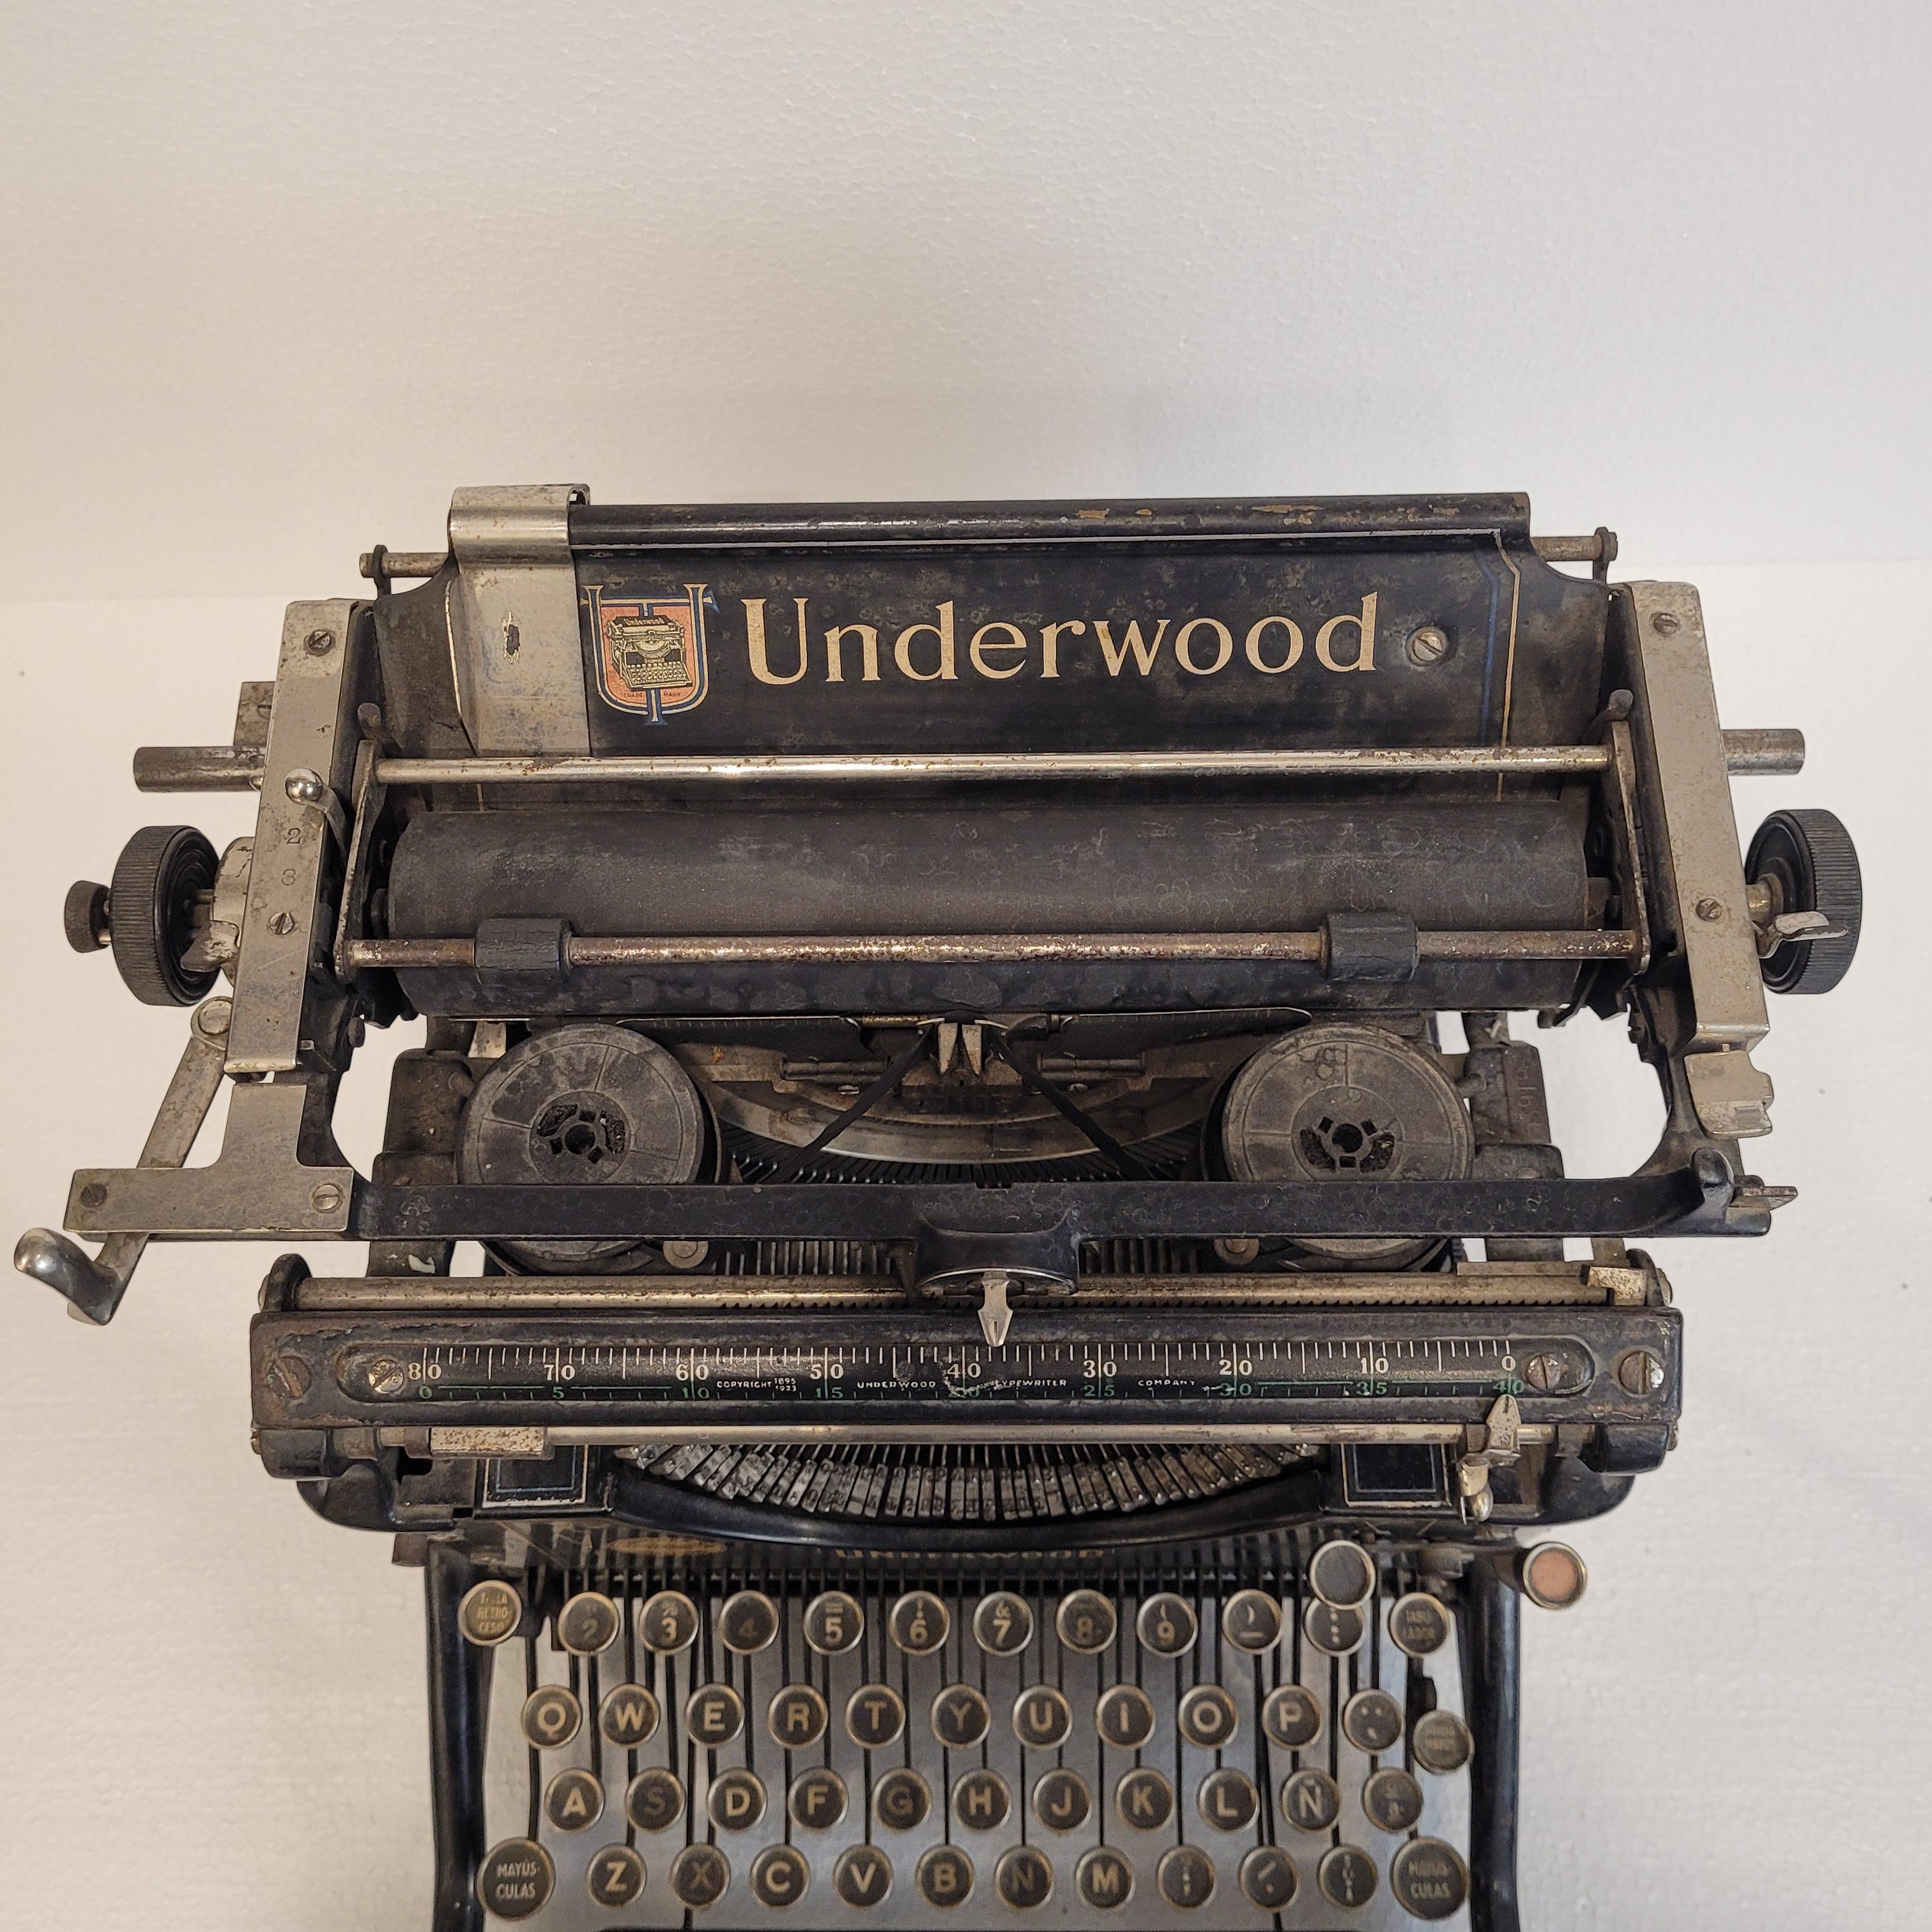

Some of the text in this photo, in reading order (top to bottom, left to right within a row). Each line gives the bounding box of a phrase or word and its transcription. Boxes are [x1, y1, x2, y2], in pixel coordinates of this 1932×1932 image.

[740, 592, 1377, 685] Underwood
[286, 828, 301, 845] 2
[1501, 1355, 1517, 1372] 0
[553, 1386, 565, 1400] 5
[857, 1381, 937, 1389] UNDERWOOD
[661, 1616, 678, 1642] 3
[737, 1617, 759, 1637] 4
[825, 1616, 843, 1644] 5
[910, 1619, 928, 1644] 6
[992, 1618, 1011, 1646] 7
[1076, 1616, 1094, 1644] 8
[1156, 1621, 1176, 1646] 9
[538, 1703, 567, 1738] Q
[615, 1703, 644, 1731] W
[704, 1703, 726, 1731] E
[787, 1703, 809, 1732] R
[864, 1702, 887, 1730] T
[949, 1703, 973, 1730] Y
[1029, 1702, 1052, 1731] U
[1120, 1703, 1128, 1732] I
[1193, 1701, 1223, 1733] O
[1280, 1702, 1303, 1732] P
[562, 1788, 587, 1818] A
[643, 1786, 666, 1815] S
[726, 1788, 751, 1817] D
[808, 1786, 829, 1815] F
[886, 1787, 914, 1814] G
[969, 1787, 992, 1815] H
[1051, 1788, 1071, 1816] J
[1132, 1787, 1154, 1815] K
[1216, 1788, 1238, 1817] L
[605, 1861, 627, 1892] Z
[691, 1862, 712, 1890] X
[767, 1861, 791, 1893] C
[850, 1862, 877, 1893] V
[934, 1862, 957, 1893] B
[1013, 1864, 1034, 1892] N
[1092, 1863, 1119, 1893] M
[495, 1882, 537, 1900] CULAS
[1410, 1882, 1453, 1900] CULAS
